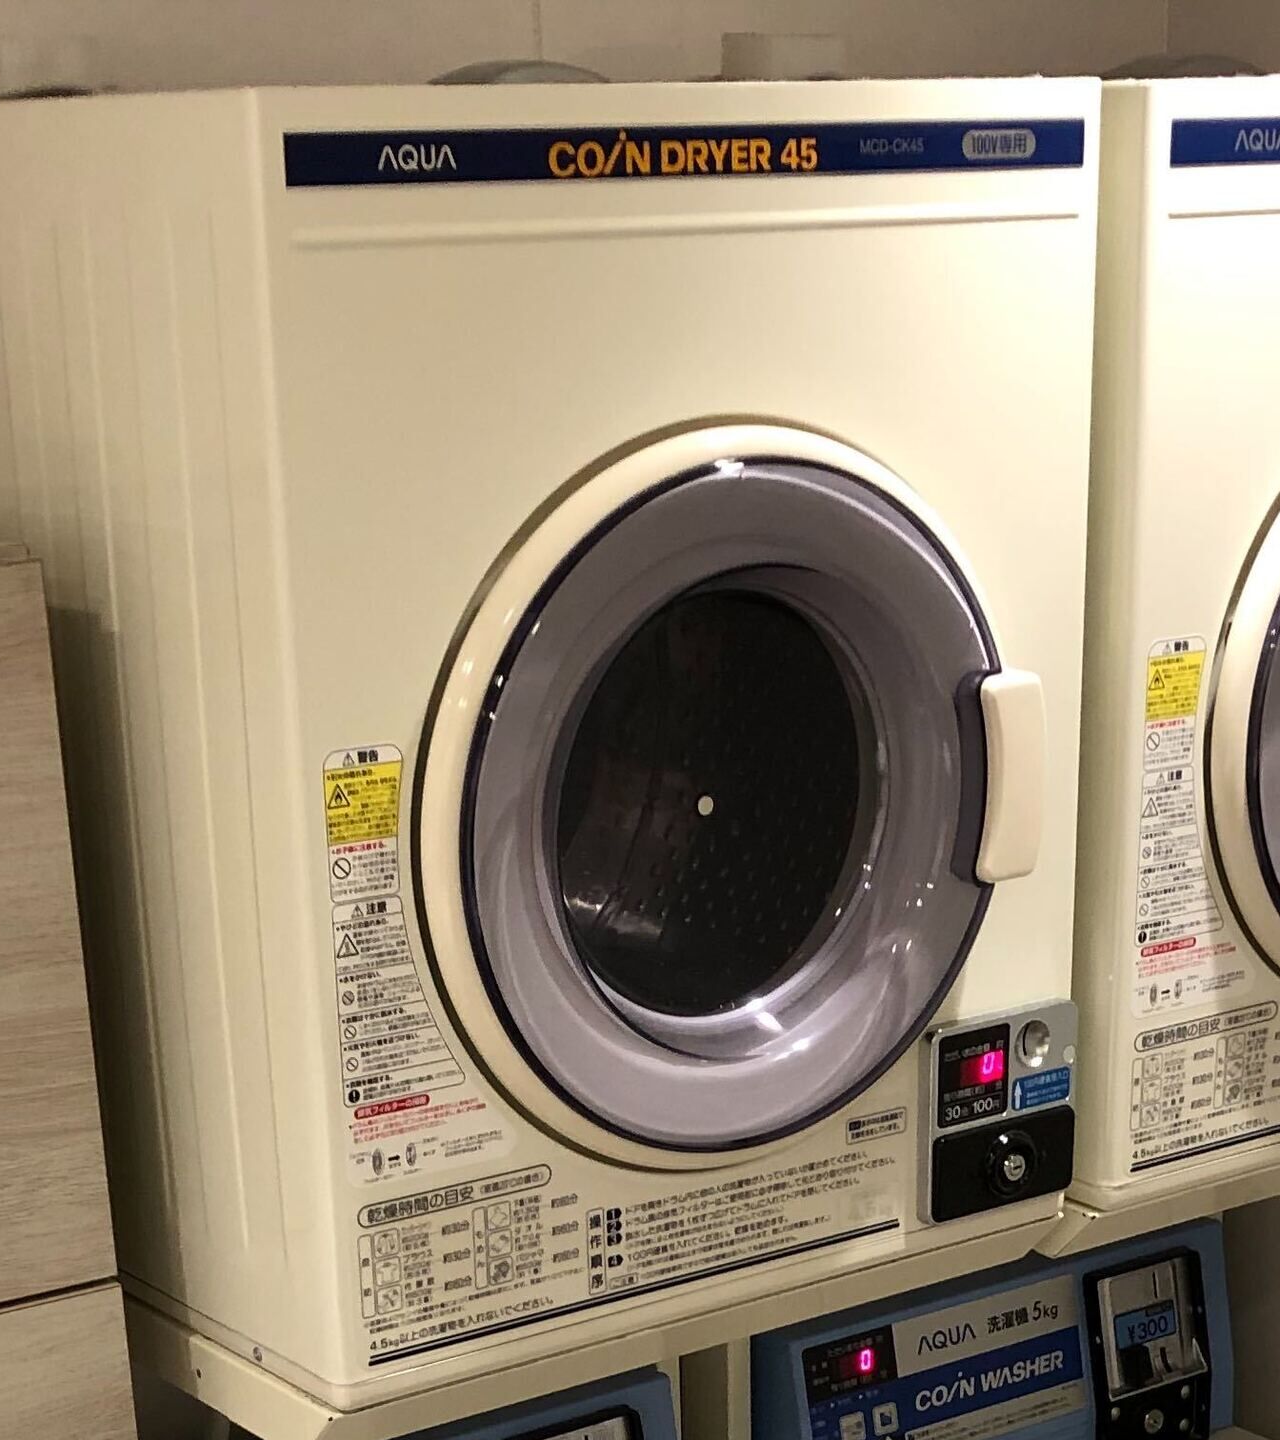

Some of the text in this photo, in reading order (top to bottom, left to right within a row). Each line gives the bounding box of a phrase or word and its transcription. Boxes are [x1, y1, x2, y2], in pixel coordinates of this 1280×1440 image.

[378, 144, 456, 171] AQUA
[661, 137, 771, 174] DRYER
[780, 138, 818, 172] 45
[918, 1323, 976, 1356] AQUA
[1032, 1300, 1059, 1320] 5kg
[1127, 1315, 1168, 1342] ¥300
[860, 1349, 871, 1371] 0
[981, 1350, 1064, 1393] WASHER
